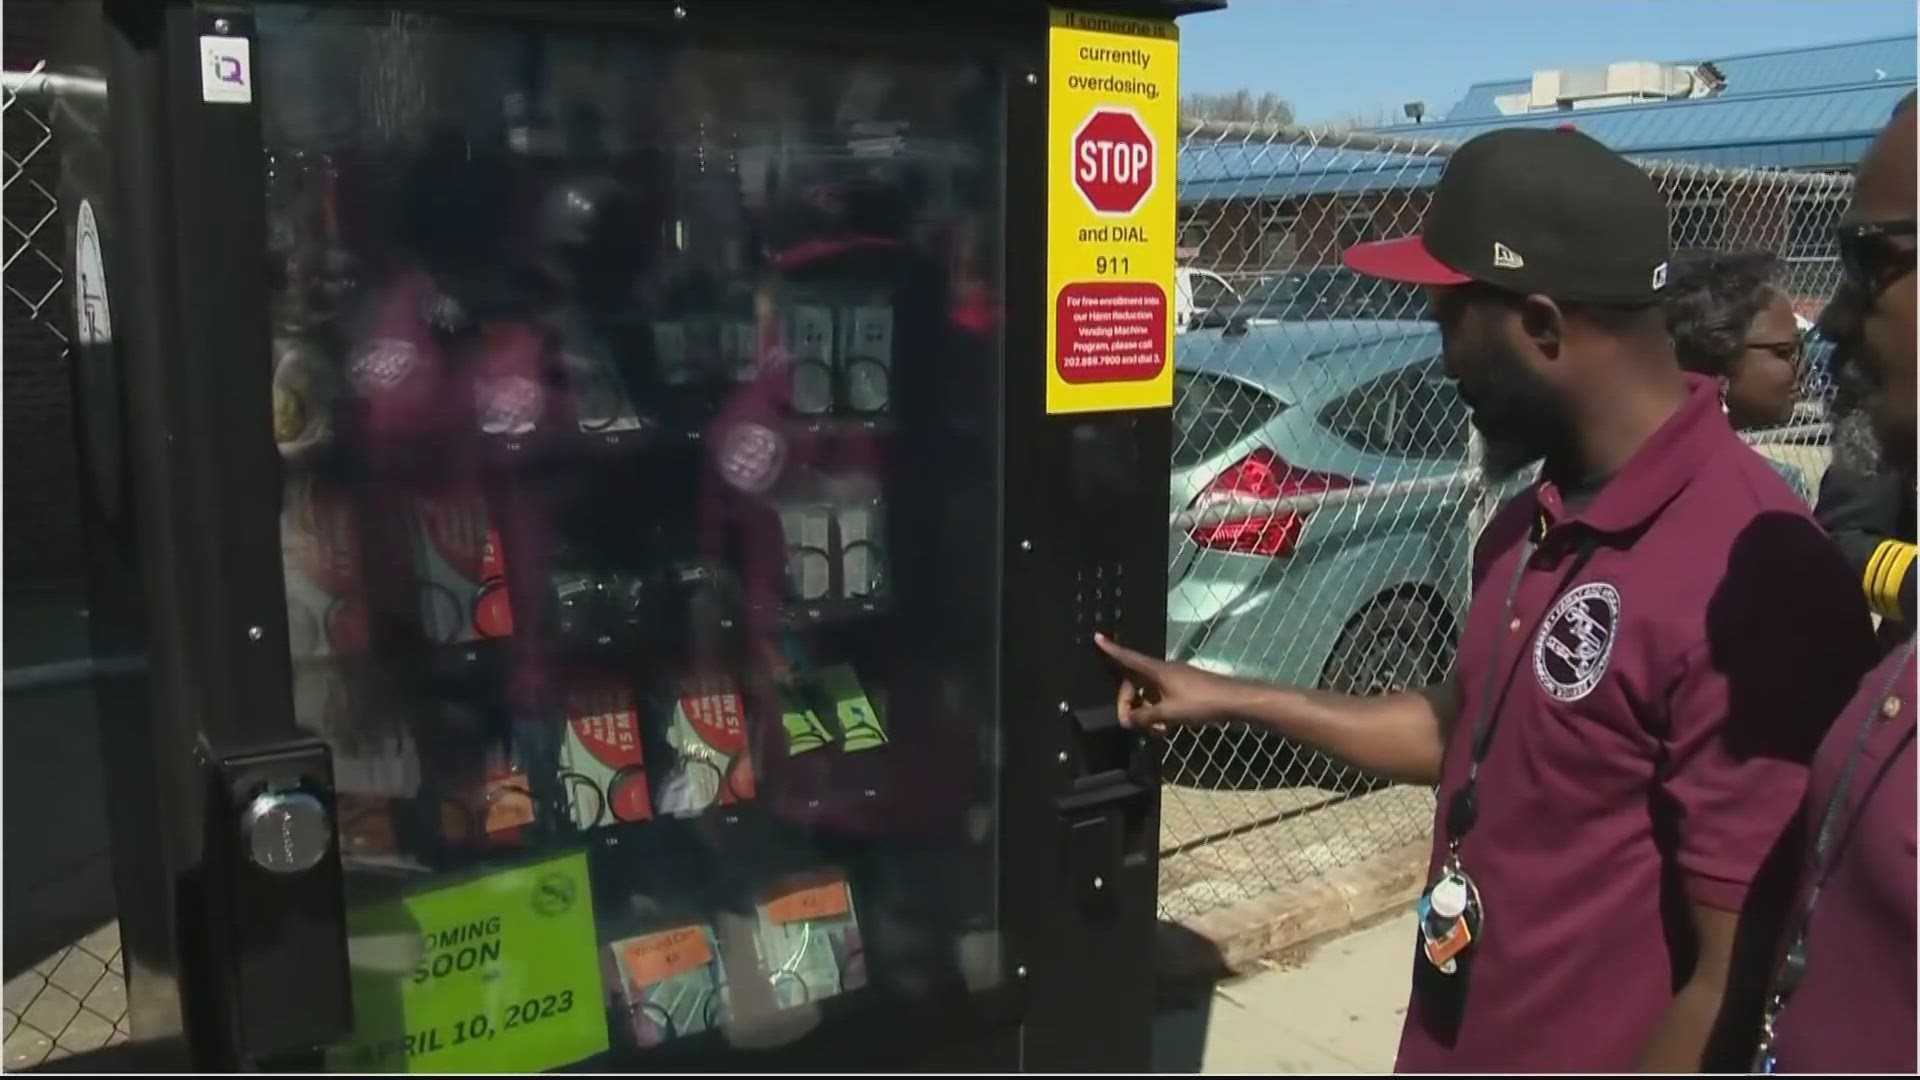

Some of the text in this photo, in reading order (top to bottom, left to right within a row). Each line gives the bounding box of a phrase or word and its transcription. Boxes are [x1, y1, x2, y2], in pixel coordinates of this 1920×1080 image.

[1080, 47, 1150, 69] currently
[1068, 75, 1159, 99] overdosing,
[1080, 140, 1149, 184] STOP
[1079, 226, 1148, 242] and DIAL
[1096, 256, 1129, 274] 911
[1067, 296, 1160, 307] For free enrollment into
[1073, 311, 1153, 322] our Harm Reduction
[1079, 326, 1148, 337] Vending Machine
[1073, 339, 1153, 353] Program, please call
[1121, 355, 1137, 365] and
[1138, 354, 1153, 363] dial
[424, 917, 501, 951] OMING
[413, 940, 502, 984] SOON
[451, 1014, 496, 1046] 10,
[504, 990, 574, 1031] 2023
